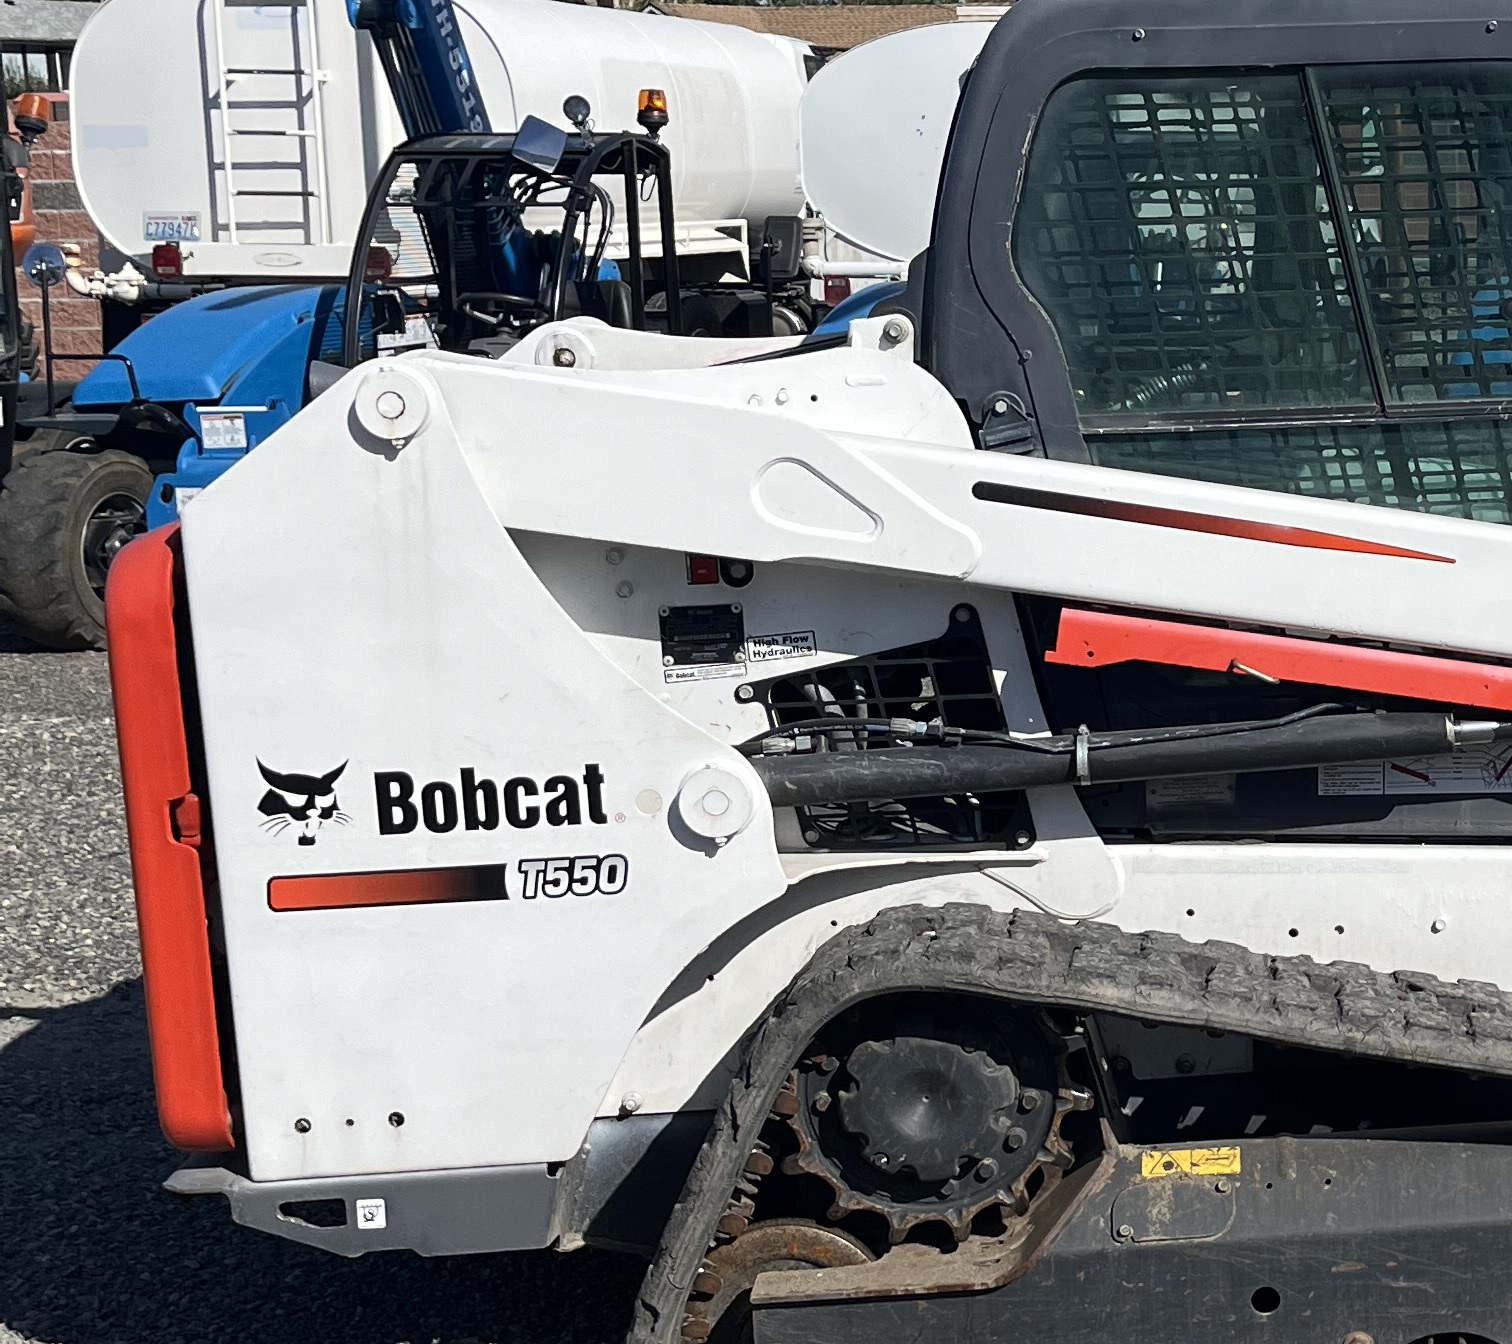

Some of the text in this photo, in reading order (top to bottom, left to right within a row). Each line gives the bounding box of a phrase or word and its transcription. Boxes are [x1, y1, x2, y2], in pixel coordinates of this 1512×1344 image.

[752, 645, 813, 659] Hydraulics
[753, 635, 809, 648] High Flow
[374, 763, 608, 835] Bobcat
[518, 853, 628, 899] T550
